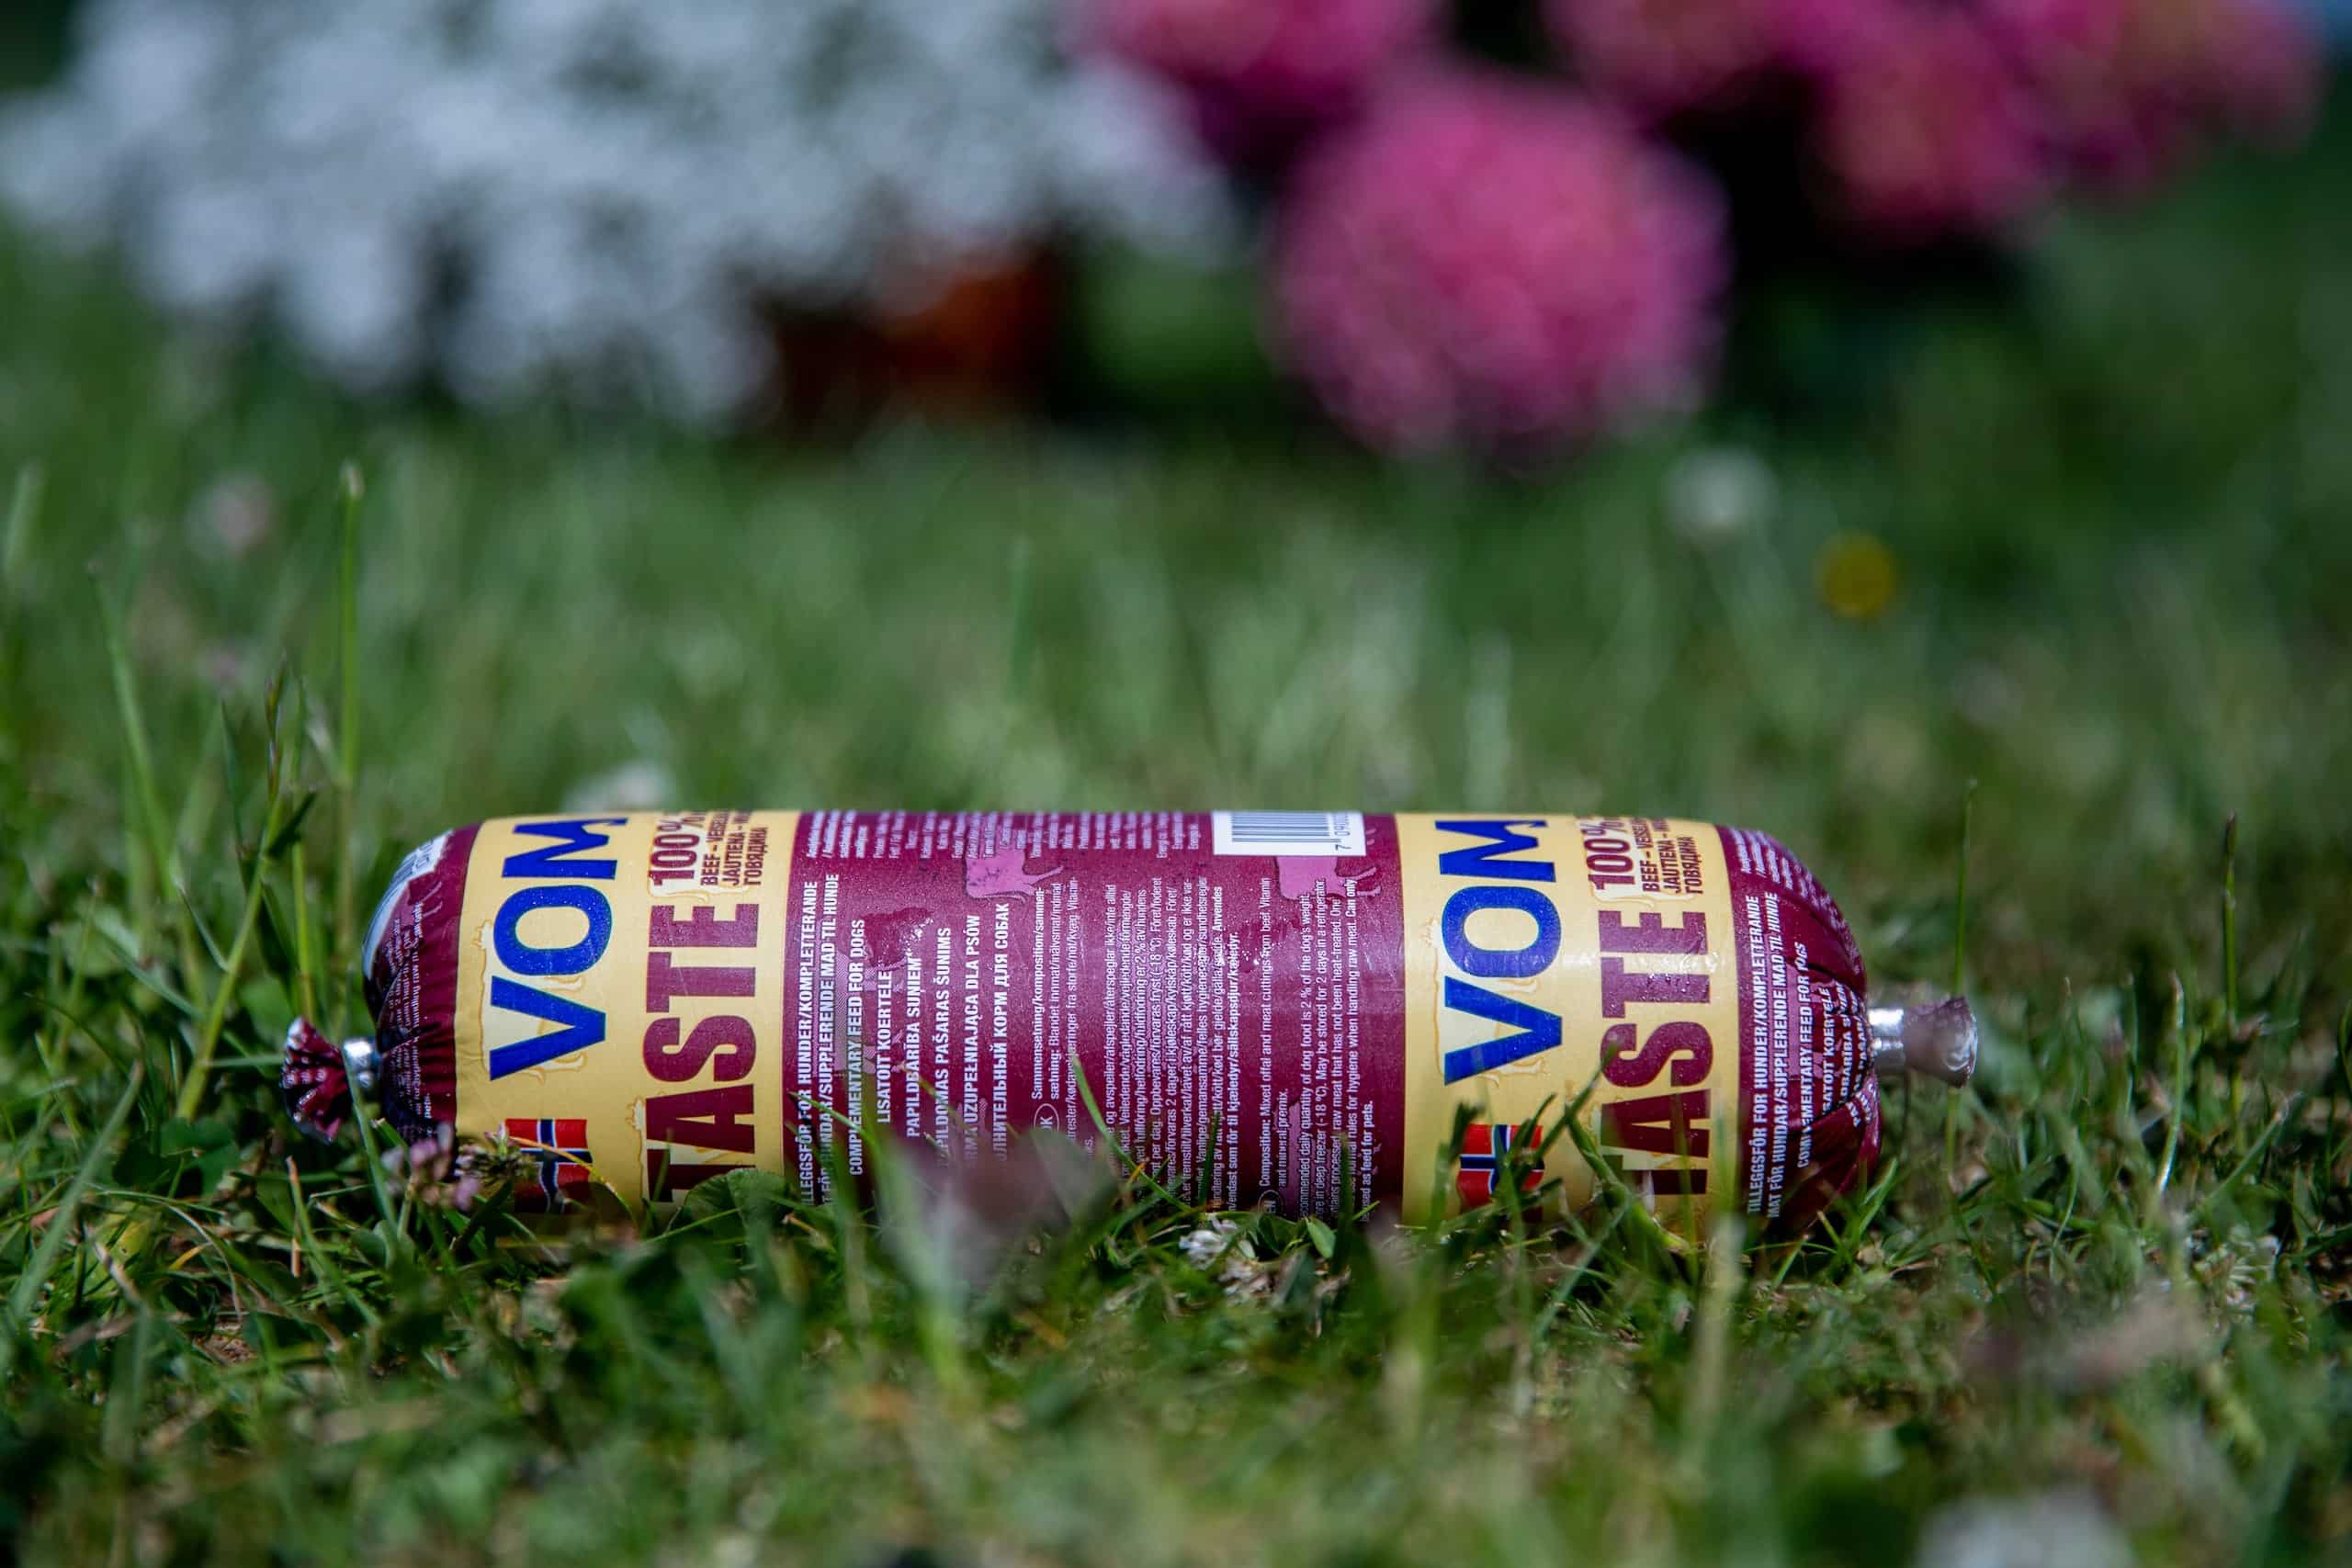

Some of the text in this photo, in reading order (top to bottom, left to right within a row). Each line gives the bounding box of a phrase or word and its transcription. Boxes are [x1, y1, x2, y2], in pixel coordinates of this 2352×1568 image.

[701, 853, 721, 885] BEEF
[723, 832, 745, 885] JAUTIENA
[744, 827, 769, 885] ГОВЯДИНА
[1657, 840, 1683, 894] JAUTIENA
[1677, 836, 1704, 894] ГОВЯДИНА
[1344, 878, 1358, 897] only
[1640, 859, 1661, 891] BEEF
[823, 874, 840, 915] HUNDE
[1182, 896, 1193, 914] ikke
[1260, 876, 1272, 908] Vitamin
[1136, 889, 1148, 926] hundens
[1213, 886, 1224, 931] Anvendes
[1330, 897, 1342, 917] One
[1346, 897, 1357, 917] Can
[1766, 891, 1782, 931] HUNDE
[821, 917, 837, 939] TIL
[1184, 916, 1193, 926] er
[1347, 919, 1358, 945] meat.
[850, 919, 865, 957] DOGS
[1136, 943, 1147, 953] %
[1137, 929, 1146, 941] av
[1183, 929, 1195, 941] og
[1316, 939, 1327, 948] in
[1770, 935, 1785, 951] TIL
[489, 817, 628, 1081] VOM
[820, 942, 835, 977] MAD
[1316, 949, 1329, 973] days
[1330, 919, 1343, 981] heat-treated.
[1350, 948, 1359, 967] raw
[1434, 819, 1563, 1087] VOM
[848, 961, 865, 991] FOR
[993, 902, 1011, 1037] КОРМ ДЛЯ СОБАК
[1137, 965, 1146, 976] er
[1301, 955, 1312, 971] the
[1772, 955, 1788, 985] MAD
[797, 881, 818, 1084] HUNDER/KOMPLETTERANDE
[1151, 977, 1163, 1001] fryst
[1261, 958, 1273, 1001] cuttings
[1301, 974, 1312, 985] of
[1301, 987, 1312, 998] %
[1317, 985, 1328, 1000] for
[1347, 970, 1361, 1014] handling
[1747, 896, 1769, 1089] HUNDER/KOMPLETTERANDE
[932, 927, 952, 1064] PAŠARAS ŠUNIMS
[1067, 994, 1077, 1009] fra
[1301, 1000, 1312, 1009] 2
[1332, 984, 1342, 1010] been
[848, 997, 863, 1036] FEED
[963, 914, 983, 1123] UZUPEŁNIAJĄCA DLA PSÓW
[1181, 1013, 1193, 1032] rått
[1261, 1003, 1272, 1031] meat
[1301, 1010, 1312, 1021] is
[1317, 1004, 1328, 1038] stored
[1332, 1013, 1343, 1030] not
[1799, 976, 1814, 1043] FEED FOR
[1049, 1006, 1059, 1046] Blandet
[1301, 1022, 1312, 1046] food
[1348, 1017, 1360, 1047] when
[641, 903, 760, 1202] TASTE
[876, 970, 893, 1123] LISATOIT KOERTELE
[1182, 1035, 1193, 1063] av/af
[1261, 1033, 1272, 1055] and
[1317, 1040, 1328, 1055] be
[1332, 1032, 1343, 1053] has
[1597, 910, 1714, 1195] TASTE
[1261, 1057, 1272, 1081] offal
[1302, 1050, 1315, 1070] dog
[1316, 1056, 1330, 1080] May
[1332, 1055, 1343, 1077] that
[1347, 1050, 1361, 1092] hygiene
[1166, 1064, 1179, 1096] dager
[1301, 1073, 1312, 1084] of
[1772, 989, 1789, 1162] HUNDAR/SUPPLERENDE
[797, 1089, 813, 1120] FOR
[1166, 1098, 1177, 1106] 2
[1261, 1084, 1272, 1116] Mixed
[1332, 1079, 1343, 1107] meat
[1347, 1093, 1358, 1110] for
[1106, 1111, 1117, 1124] og
[1227, 1114, 1238, 1126] til
[1300, 1086, 1315, 1129] quantity
[1316, 1103, 1329, 1126] (-18
[1333, 1109, 1342, 1130] raw
[1363, 1100, 1375, 1127] pets.
[1753, 1093, 1769, 1122] FOR
[1276, 1088, 1290, 1187] and mineral premix.
[1347, 1111, 1358, 1138] rules
[1299, 1131, 1314, 1156] daily
[1315, 1129, 1327, 1164] freezer
[1362, 1130, 1374, 1146] for
[1230, 1146, 1238, 1168] som
[1260, 1119, 1273, 1186] Composition:
[1361, 1147, 1373, 1171] feed
[1315, 1166, 1327, 1189] deep
[1363, 1173, 1372, 1185] as
[1767, 1165, 1785, 1190] FÖR
